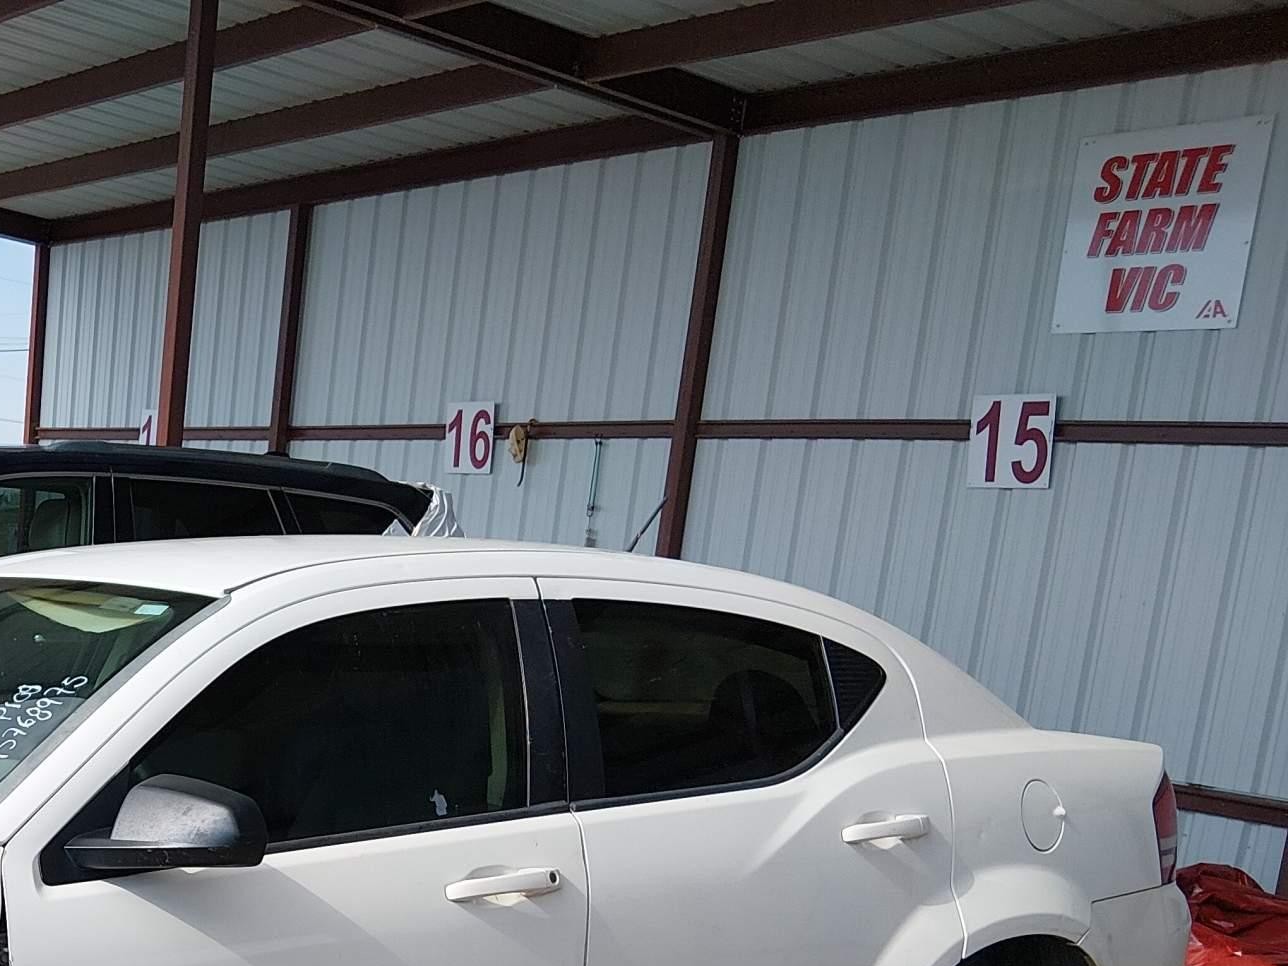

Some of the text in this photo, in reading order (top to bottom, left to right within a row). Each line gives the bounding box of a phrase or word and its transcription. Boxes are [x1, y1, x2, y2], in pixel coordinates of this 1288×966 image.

[1093, 143, 1237, 204] STATE
[1086, 203, 1220, 258] FARM
[1105, 263, 1187, 314] VIC
[447, 408, 492, 470] 16
[975, 400, 1051, 485] 15
